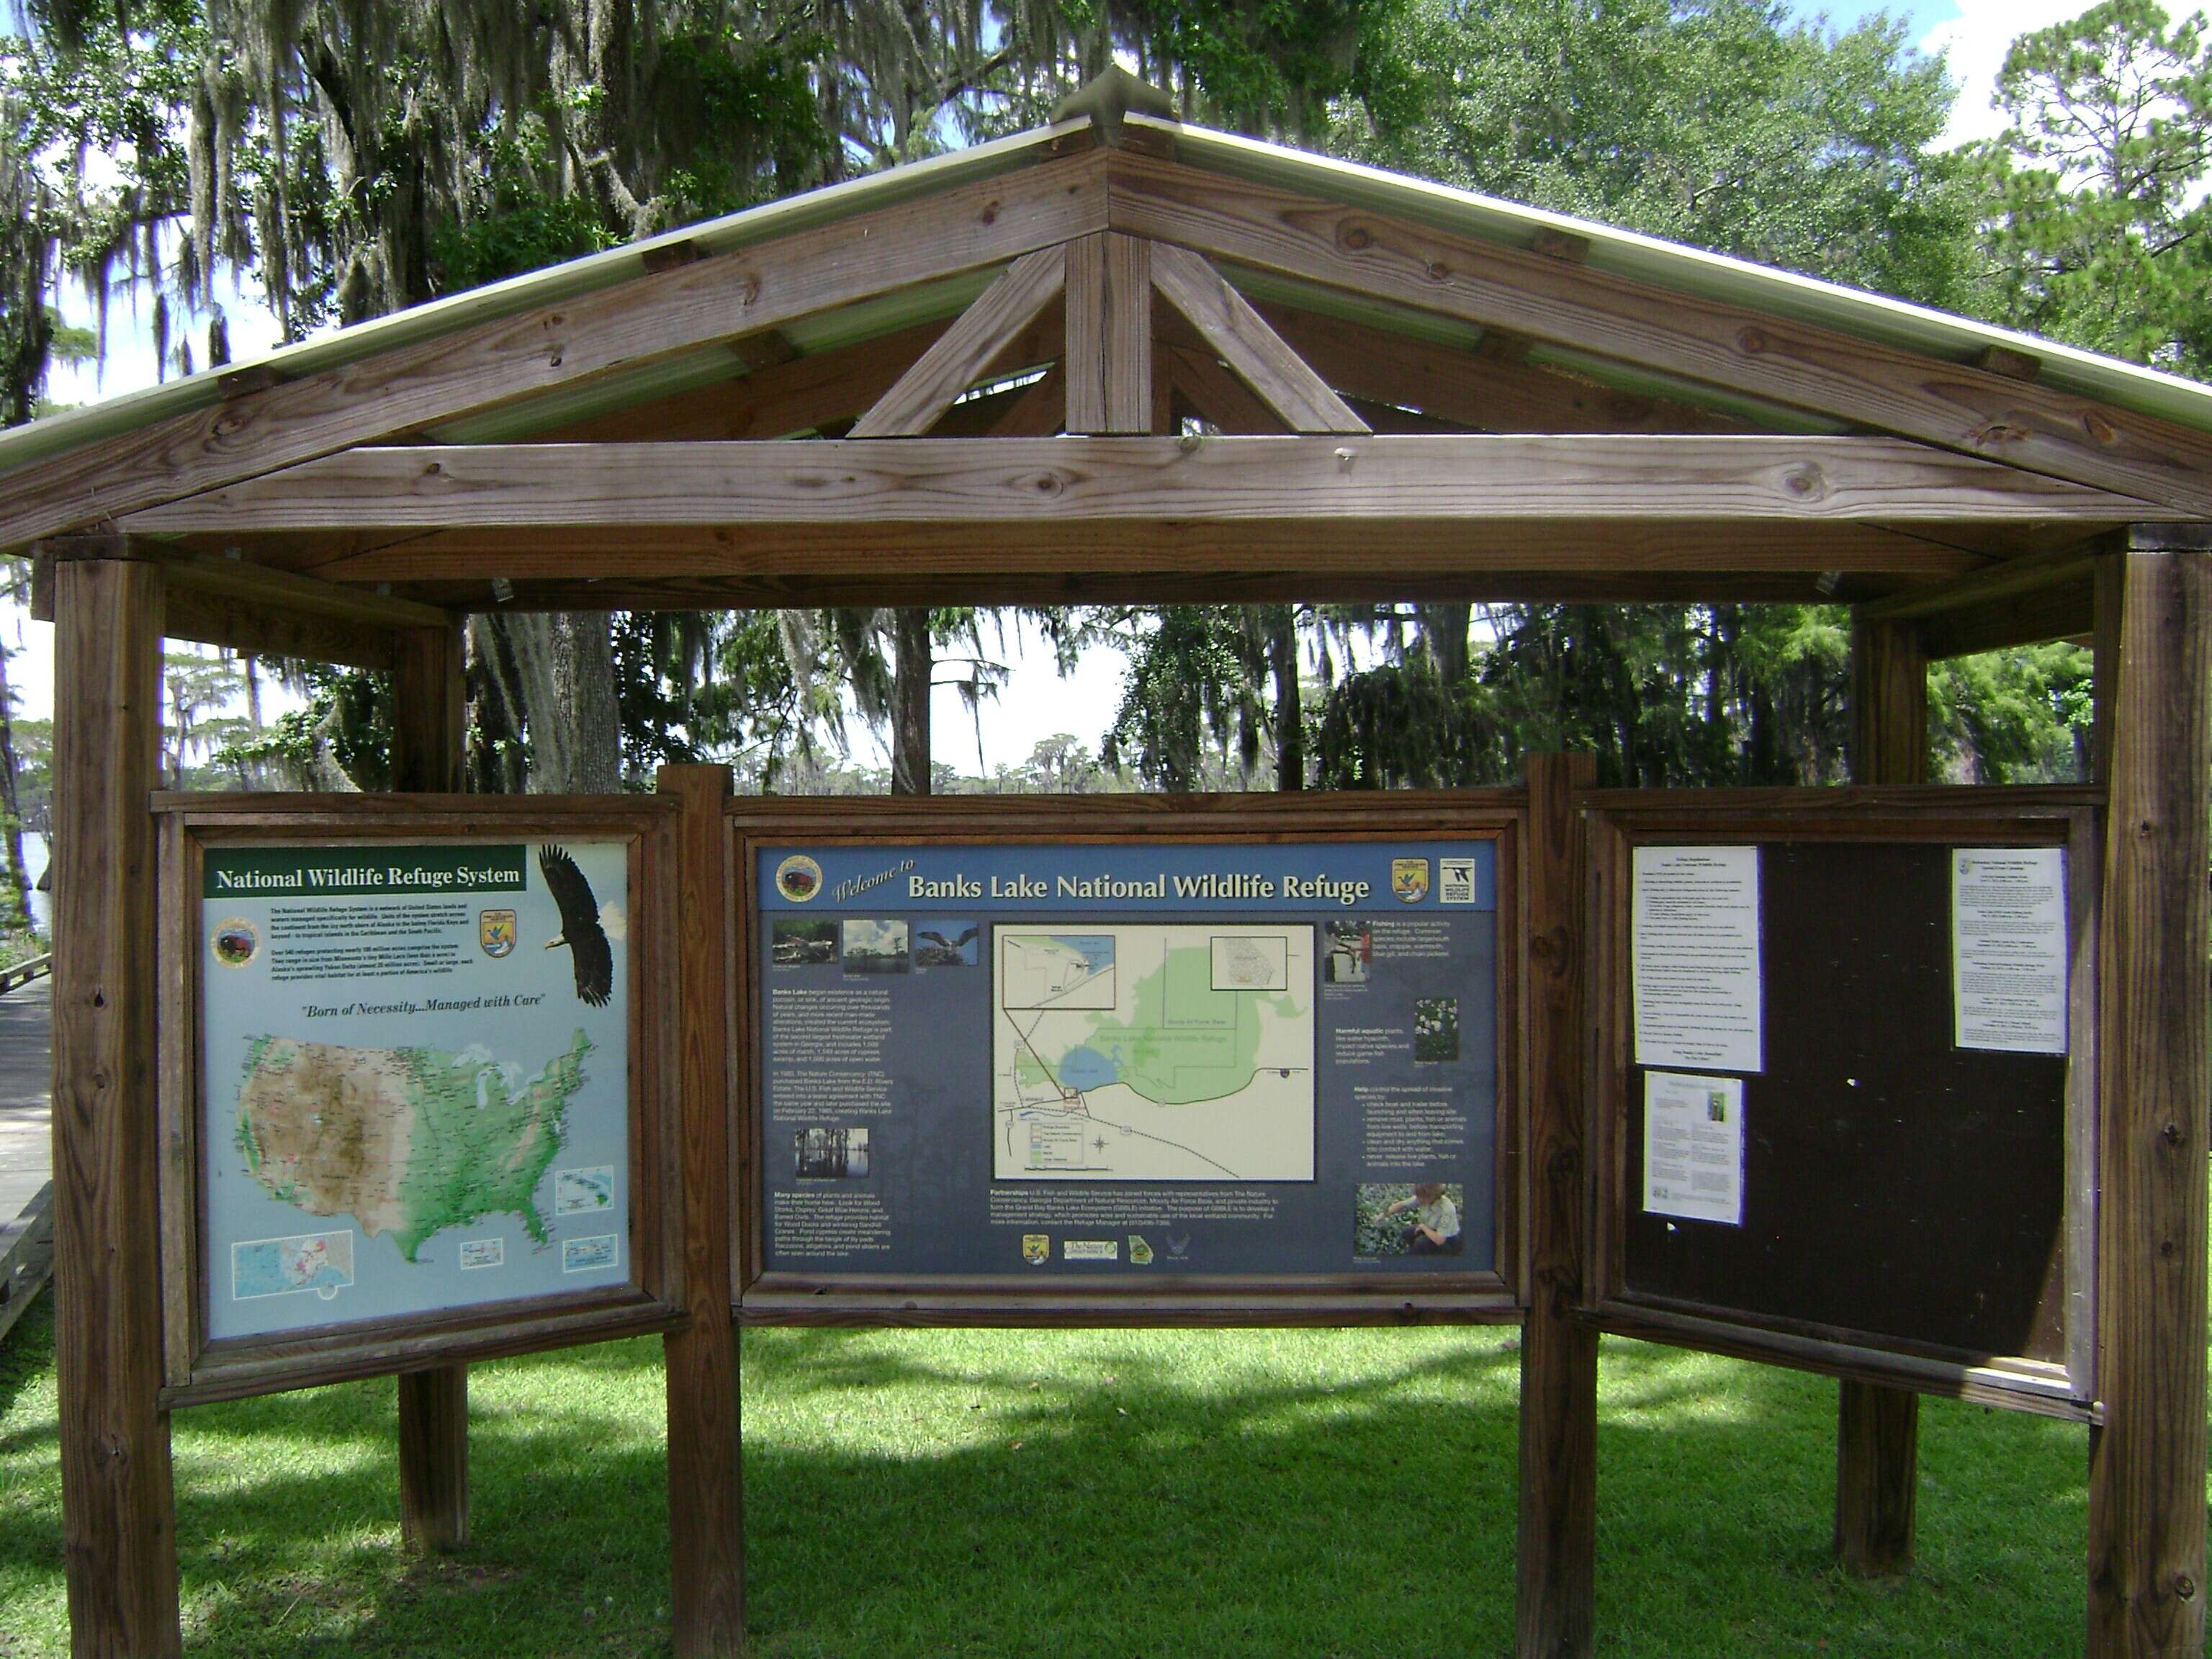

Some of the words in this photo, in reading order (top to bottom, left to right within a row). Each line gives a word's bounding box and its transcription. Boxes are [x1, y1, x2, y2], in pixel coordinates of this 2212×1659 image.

[216, 870, 302, 889] National
[308, 868, 383, 887] Wildlife
[387, 868, 453, 888] Refuge
[457, 866, 520, 889] System
[832, 867, 896, 904] Welcome
[900, 859, 915, 873] to
[909, 873, 981, 899] Banks
[991, 873, 1048, 899] Lake
[1057, 873, 1166, 898] National
[1173, 873, 1274, 898] Wildlife
[1283, 873, 1370, 906] Refuge
[341, 1004, 354, 1015] of
[484, 997, 509, 1008] with
